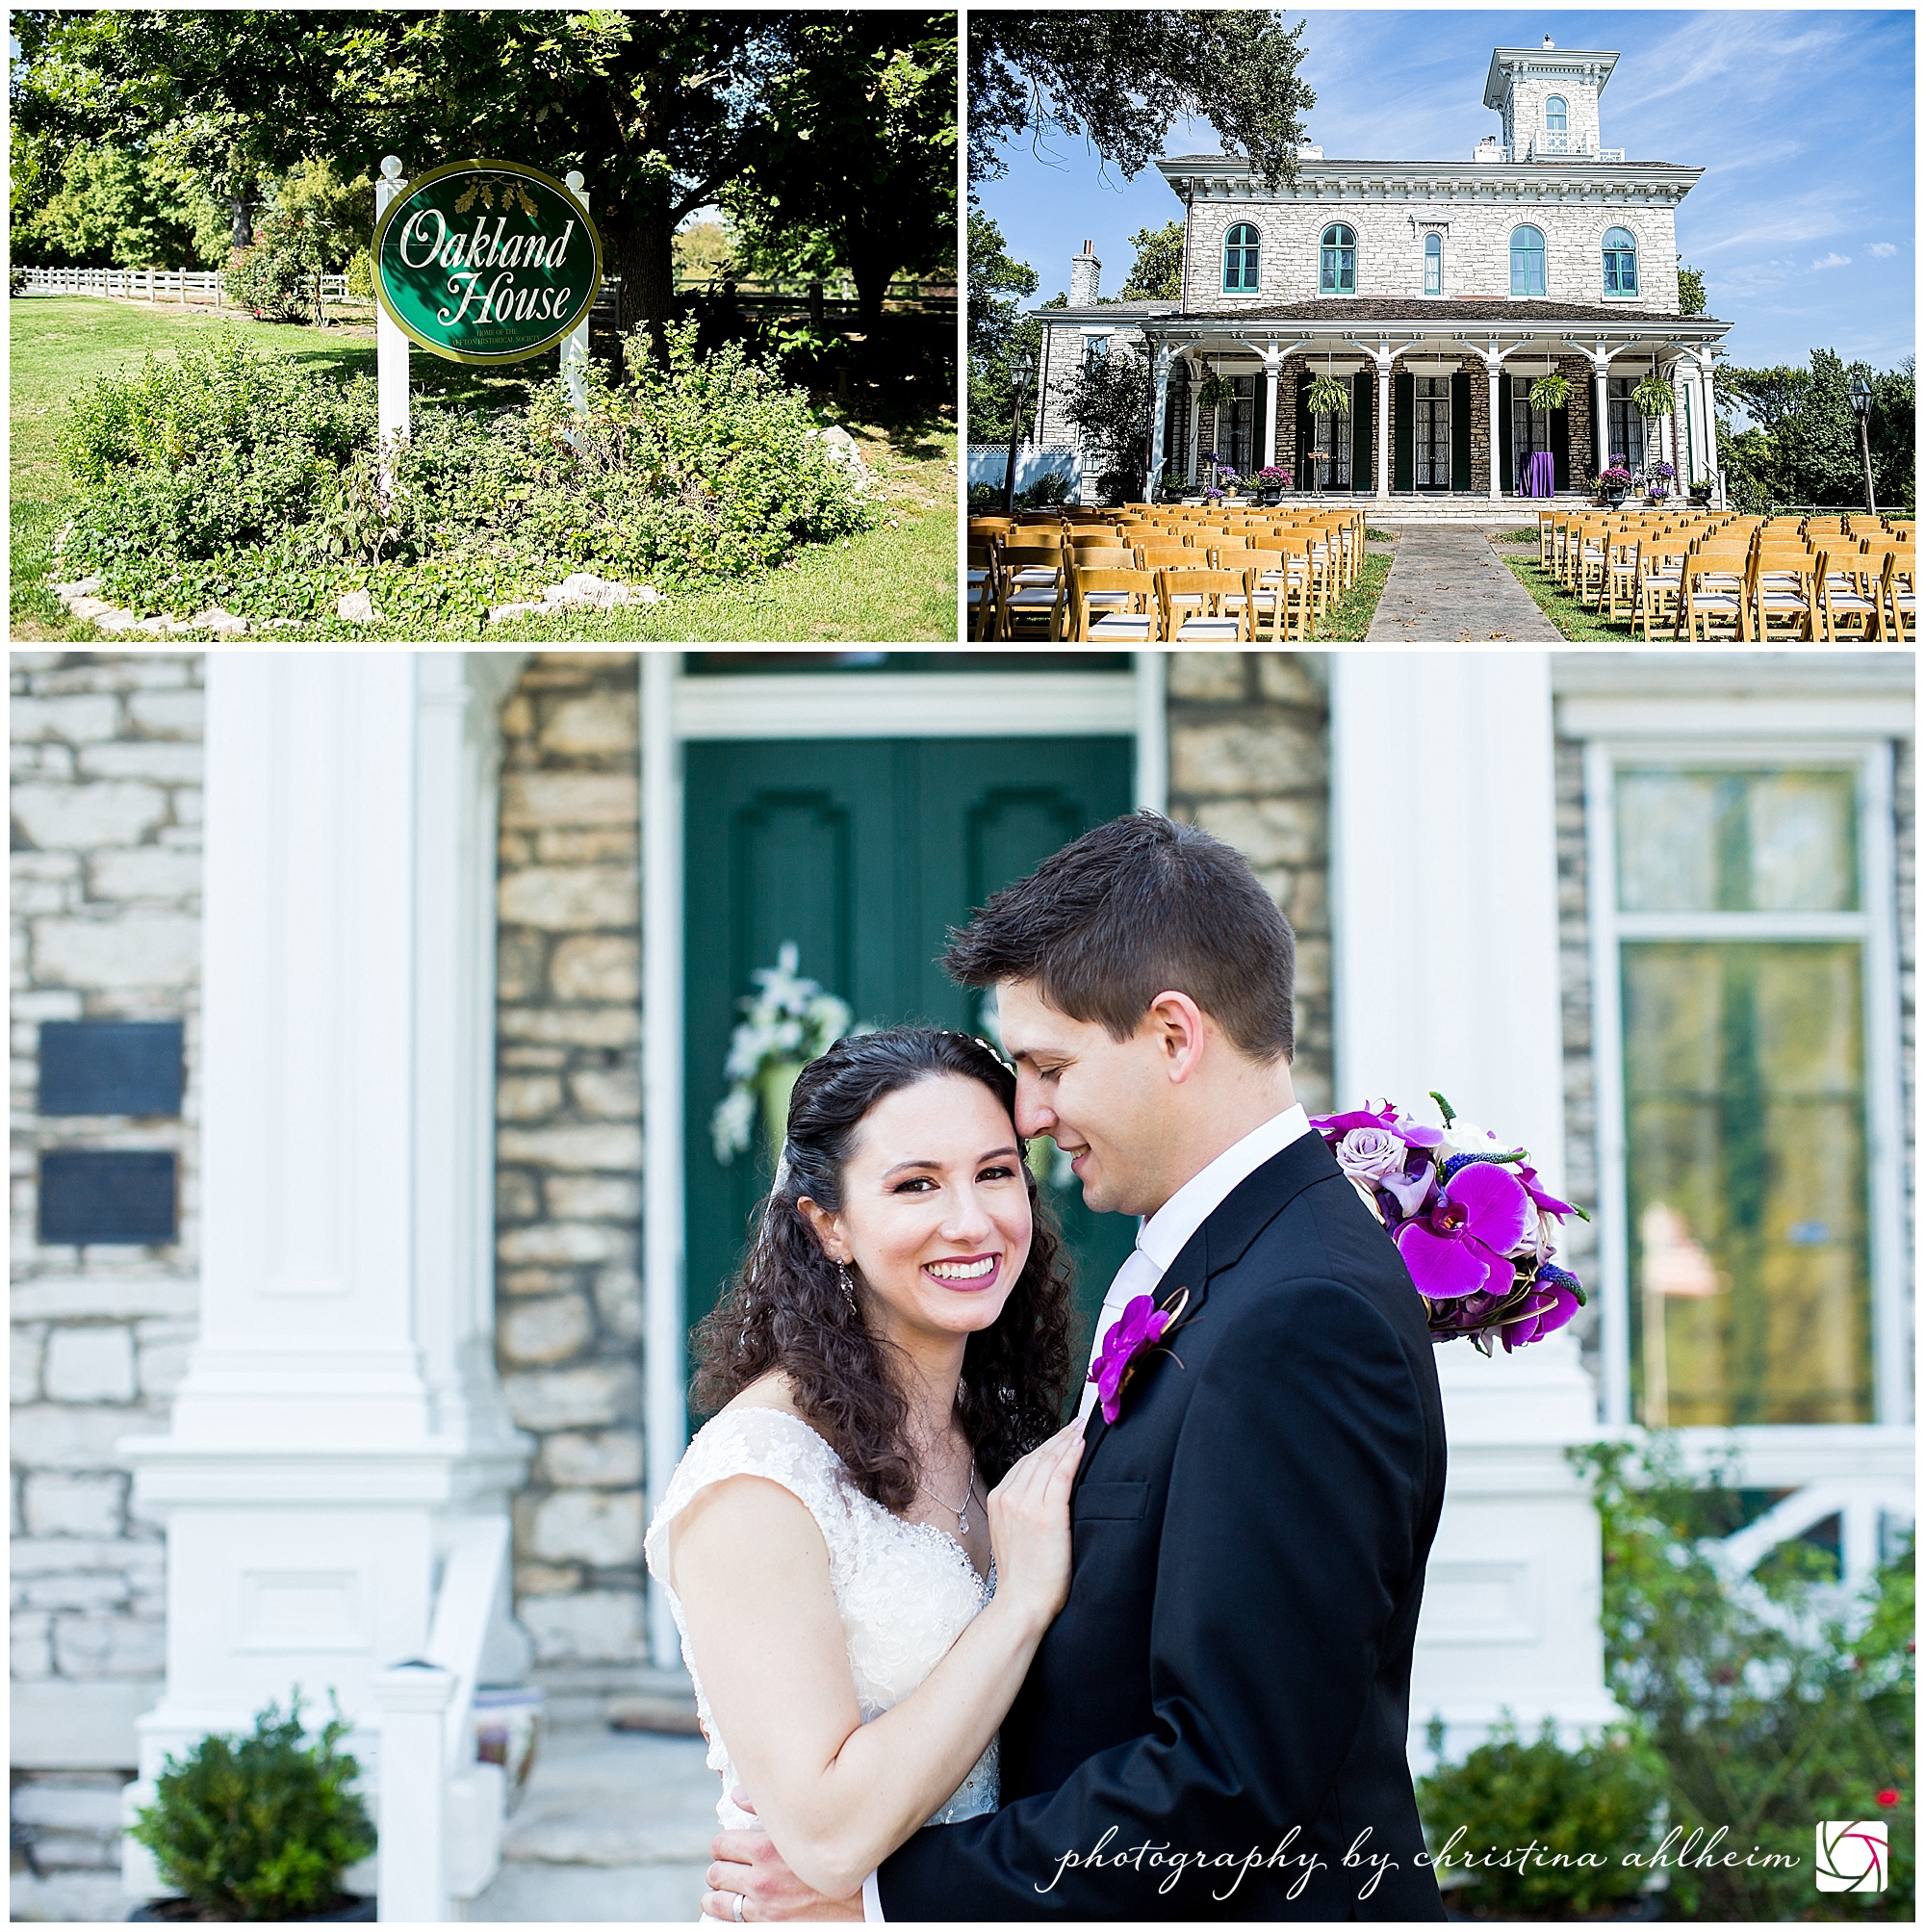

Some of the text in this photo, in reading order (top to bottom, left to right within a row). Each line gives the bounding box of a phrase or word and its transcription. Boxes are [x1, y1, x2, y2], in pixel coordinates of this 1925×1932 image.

[400, 209, 575, 268] Oakland
[437, 271, 571, 326] House
[478, 336, 513, 345] HISTORICAL
